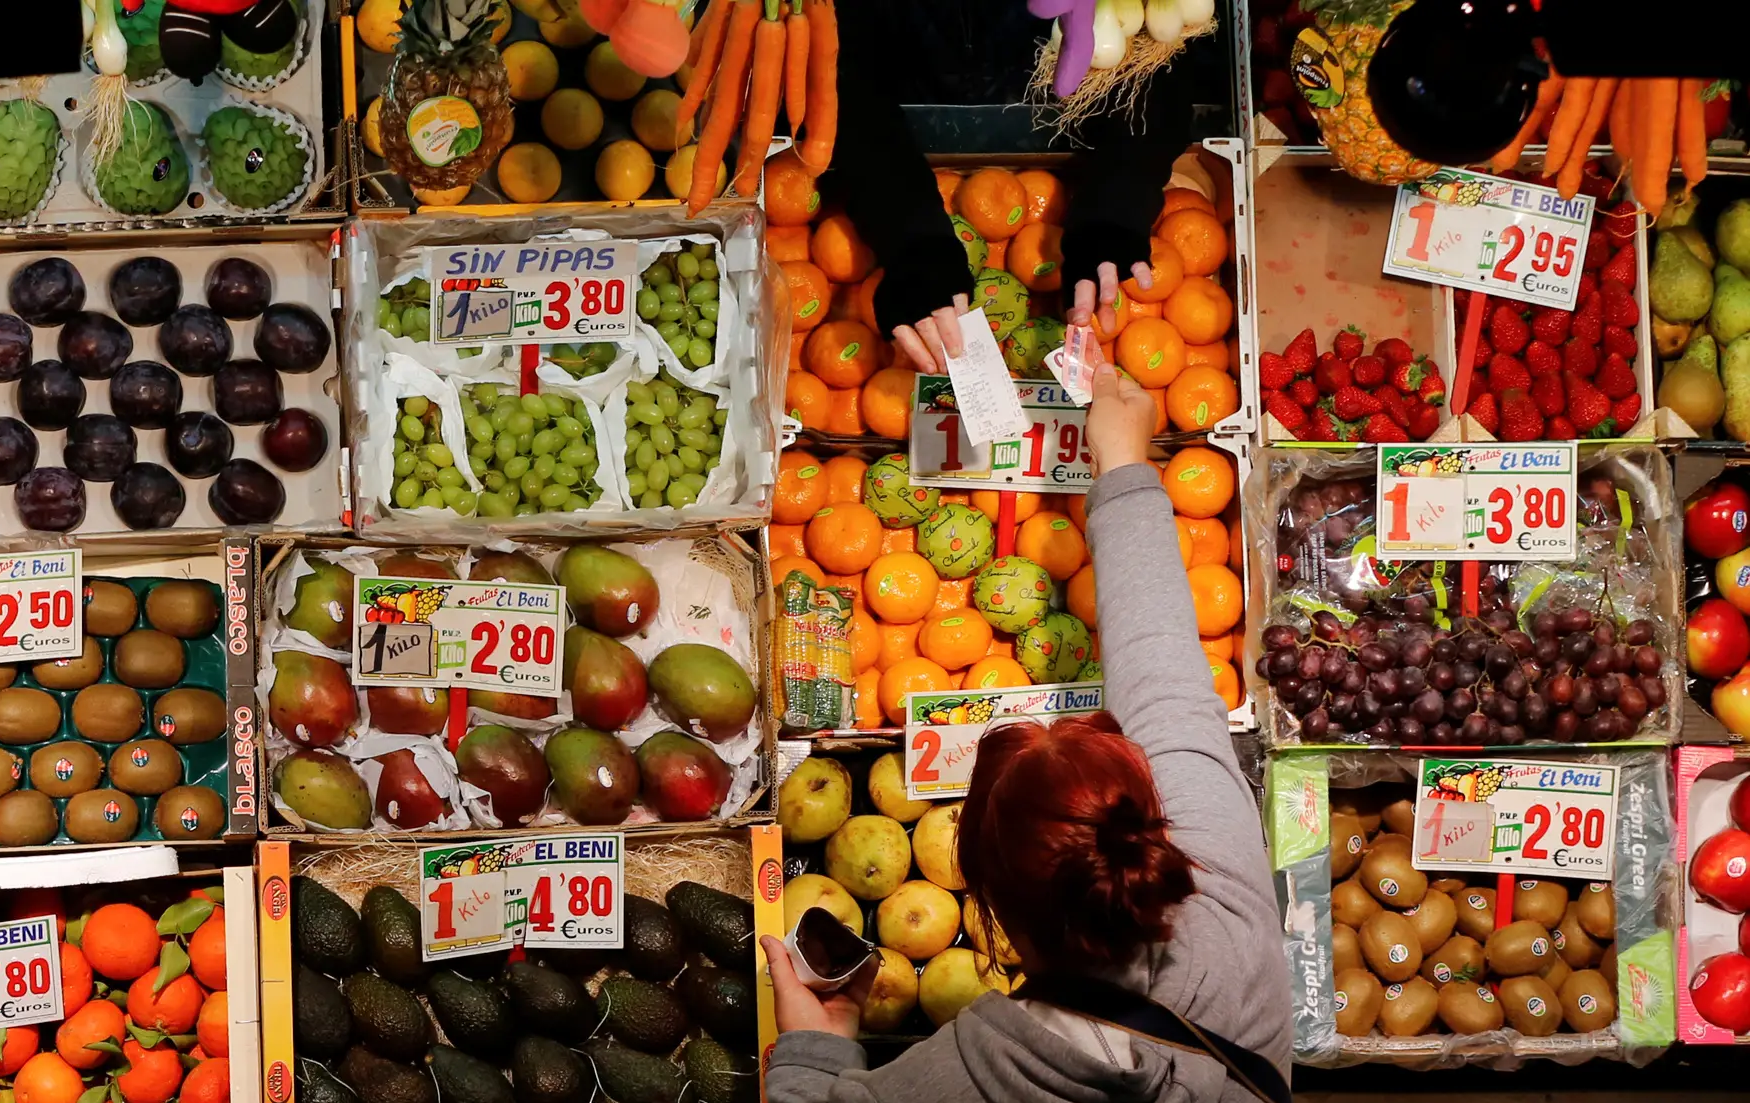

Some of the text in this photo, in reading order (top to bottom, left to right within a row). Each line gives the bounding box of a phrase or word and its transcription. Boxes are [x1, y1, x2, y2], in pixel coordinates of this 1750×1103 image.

[1406, 200, 1436, 261] 1
[1511, 191, 1586, 219] EL BENI
[1493, 223, 1578, 283] 2'95
[447, 291, 472, 338] 1
[543, 277, 626, 331] 3'80
[936, 417, 963, 472] 1
[993, 444, 1019, 469] Kilo
[1499, 454, 1519, 470] El
[1522, 450, 1562, 469] Beni
[1384, 483, 1411, 541] 1
[1486, 484, 1566, 544] 3'80
[12, 557, 65, 577] El Beni
[496, 591, 550, 608] El Beni
[360, 625, 388, 674] 1
[470, 620, 556, 675] 2'80
[1046, 689, 1101, 712] El Beni
[910, 730, 941, 783] 2
[1539, 771, 1603, 788] El Beni
[1420, 803, 1445, 856] 1
[1521, 803, 1606, 861] 2'80
[1629, 782, 1648, 840] Zespri
[534, 838, 614, 860] EL BENI
[428, 882, 457, 939] 1
[529, 872, 613, 932] 4'80
[1304, 958, 1319, 1020] Zespri
